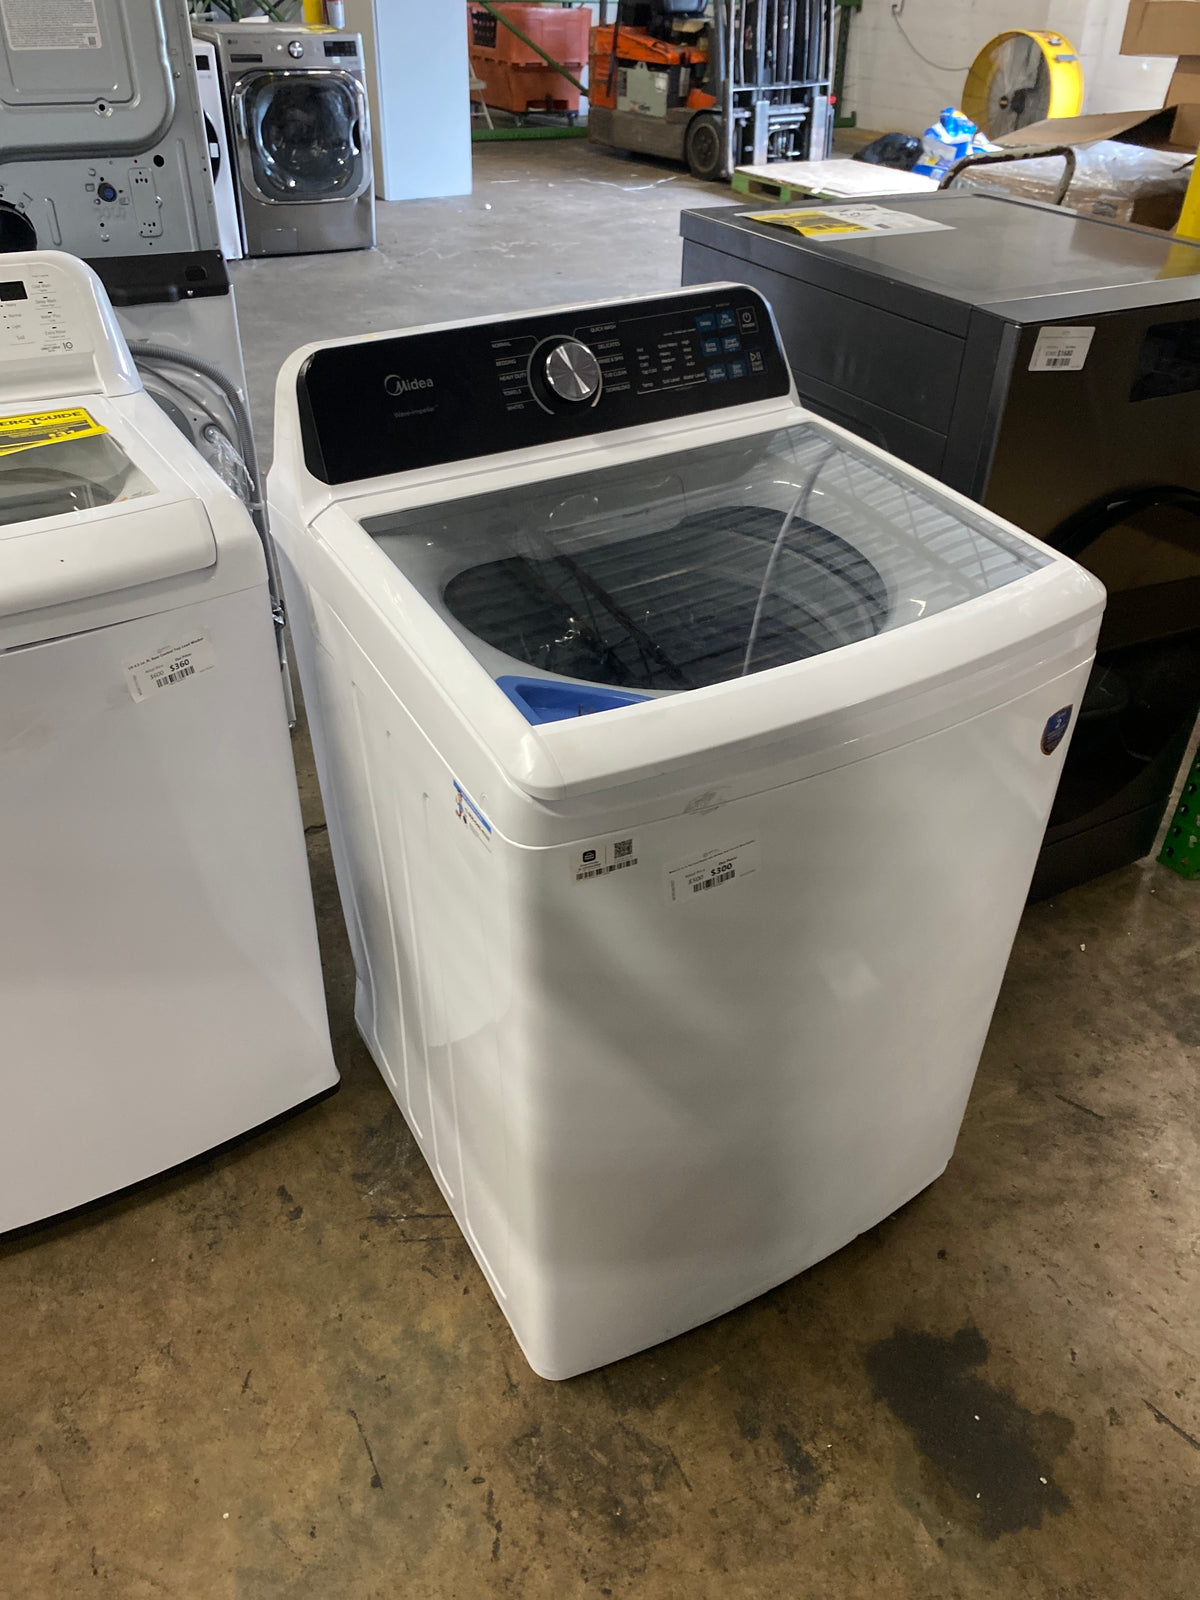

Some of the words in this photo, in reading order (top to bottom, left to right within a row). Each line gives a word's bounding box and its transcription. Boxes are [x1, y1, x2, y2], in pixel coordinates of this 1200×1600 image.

[385, 374, 434, 396] Midea
[169, 659, 190, 672] $360
[711, 863, 732, 876] $300
